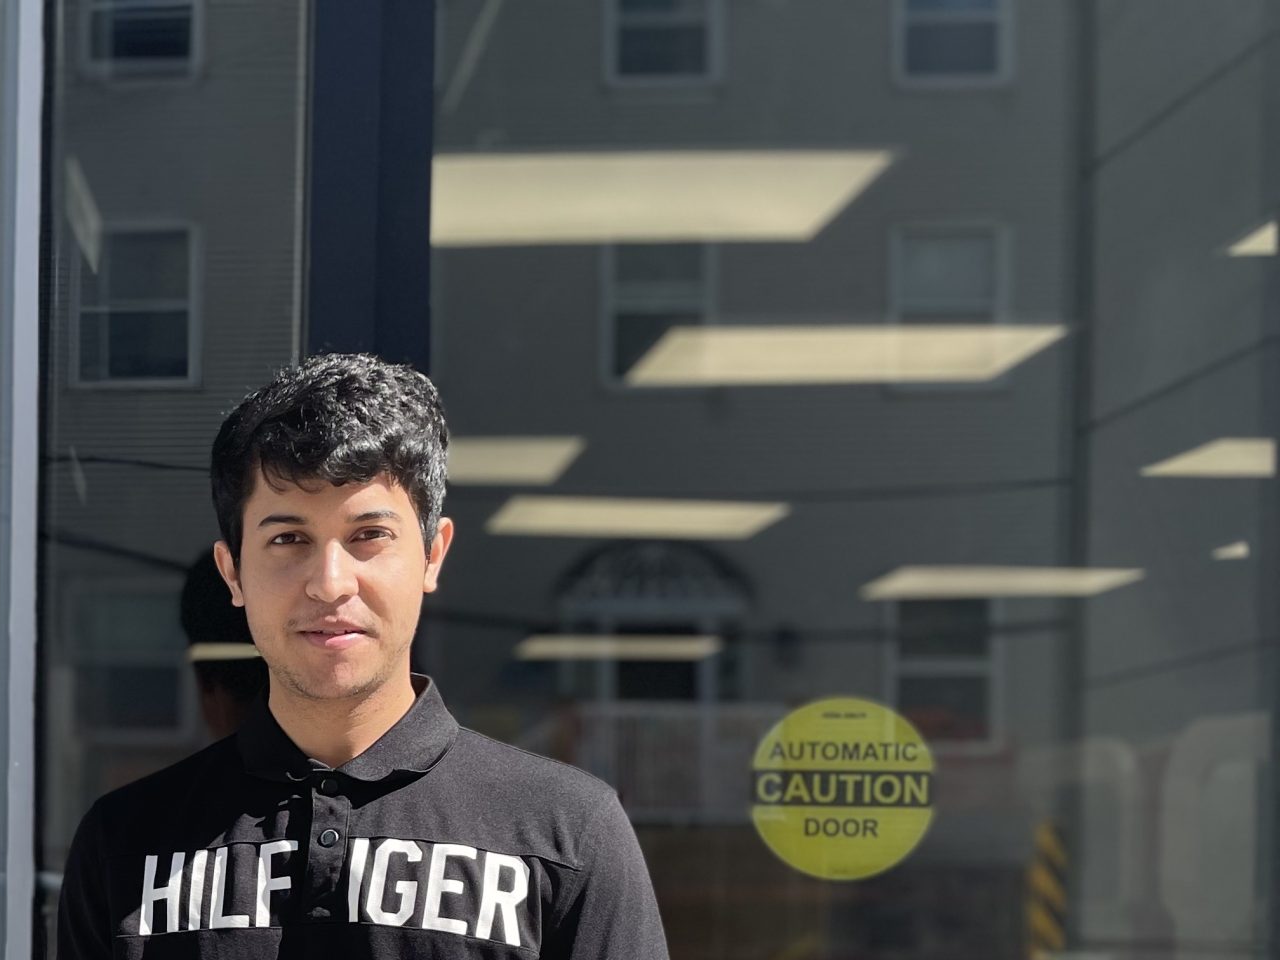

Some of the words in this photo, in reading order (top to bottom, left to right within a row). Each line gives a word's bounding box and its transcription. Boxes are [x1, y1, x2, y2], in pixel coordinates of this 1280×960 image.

[770, 742, 918, 762] AUTOMATIC
[756, 773, 929, 804] CAUTION
[804, 818, 879, 837] DOOR
